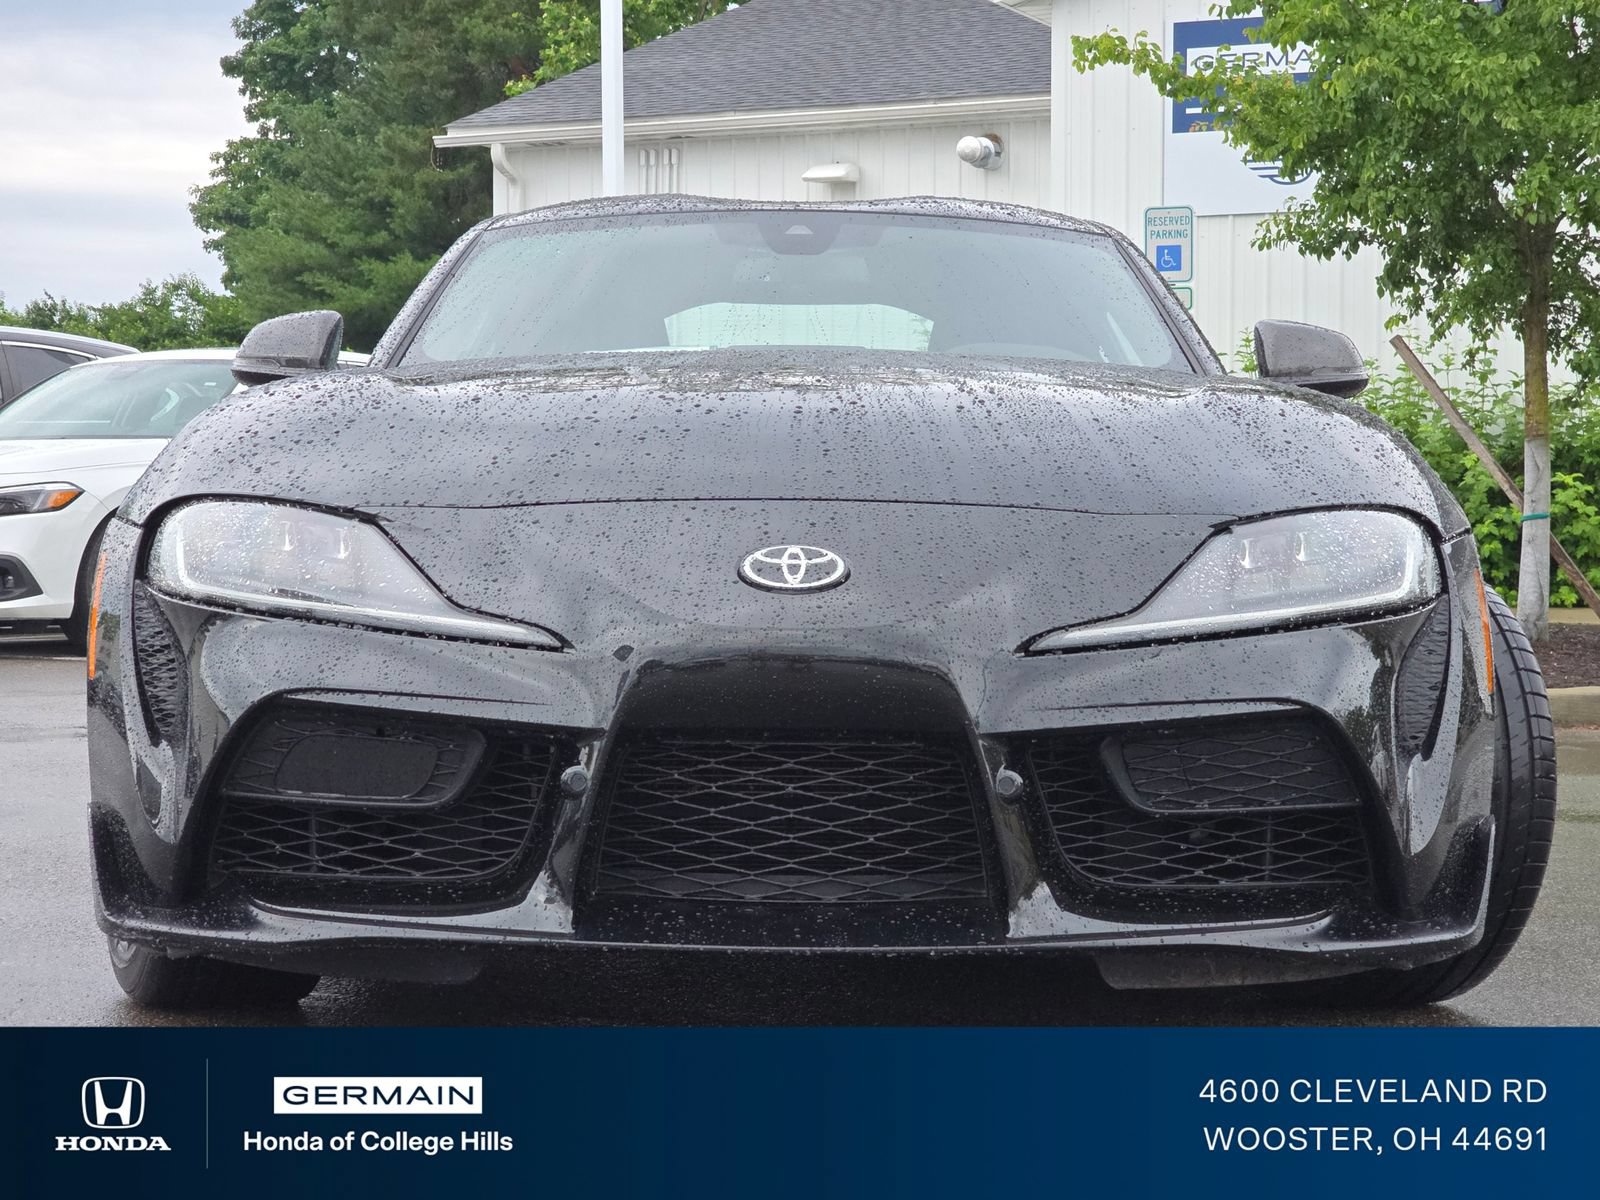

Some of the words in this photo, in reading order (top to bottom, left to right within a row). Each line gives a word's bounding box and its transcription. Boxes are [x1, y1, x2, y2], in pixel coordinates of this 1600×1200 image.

[1194, 48, 1312, 72] GERMA
[1147, 215, 1190, 227] RESERVED
[1150, 229, 1188, 240] PARKING
